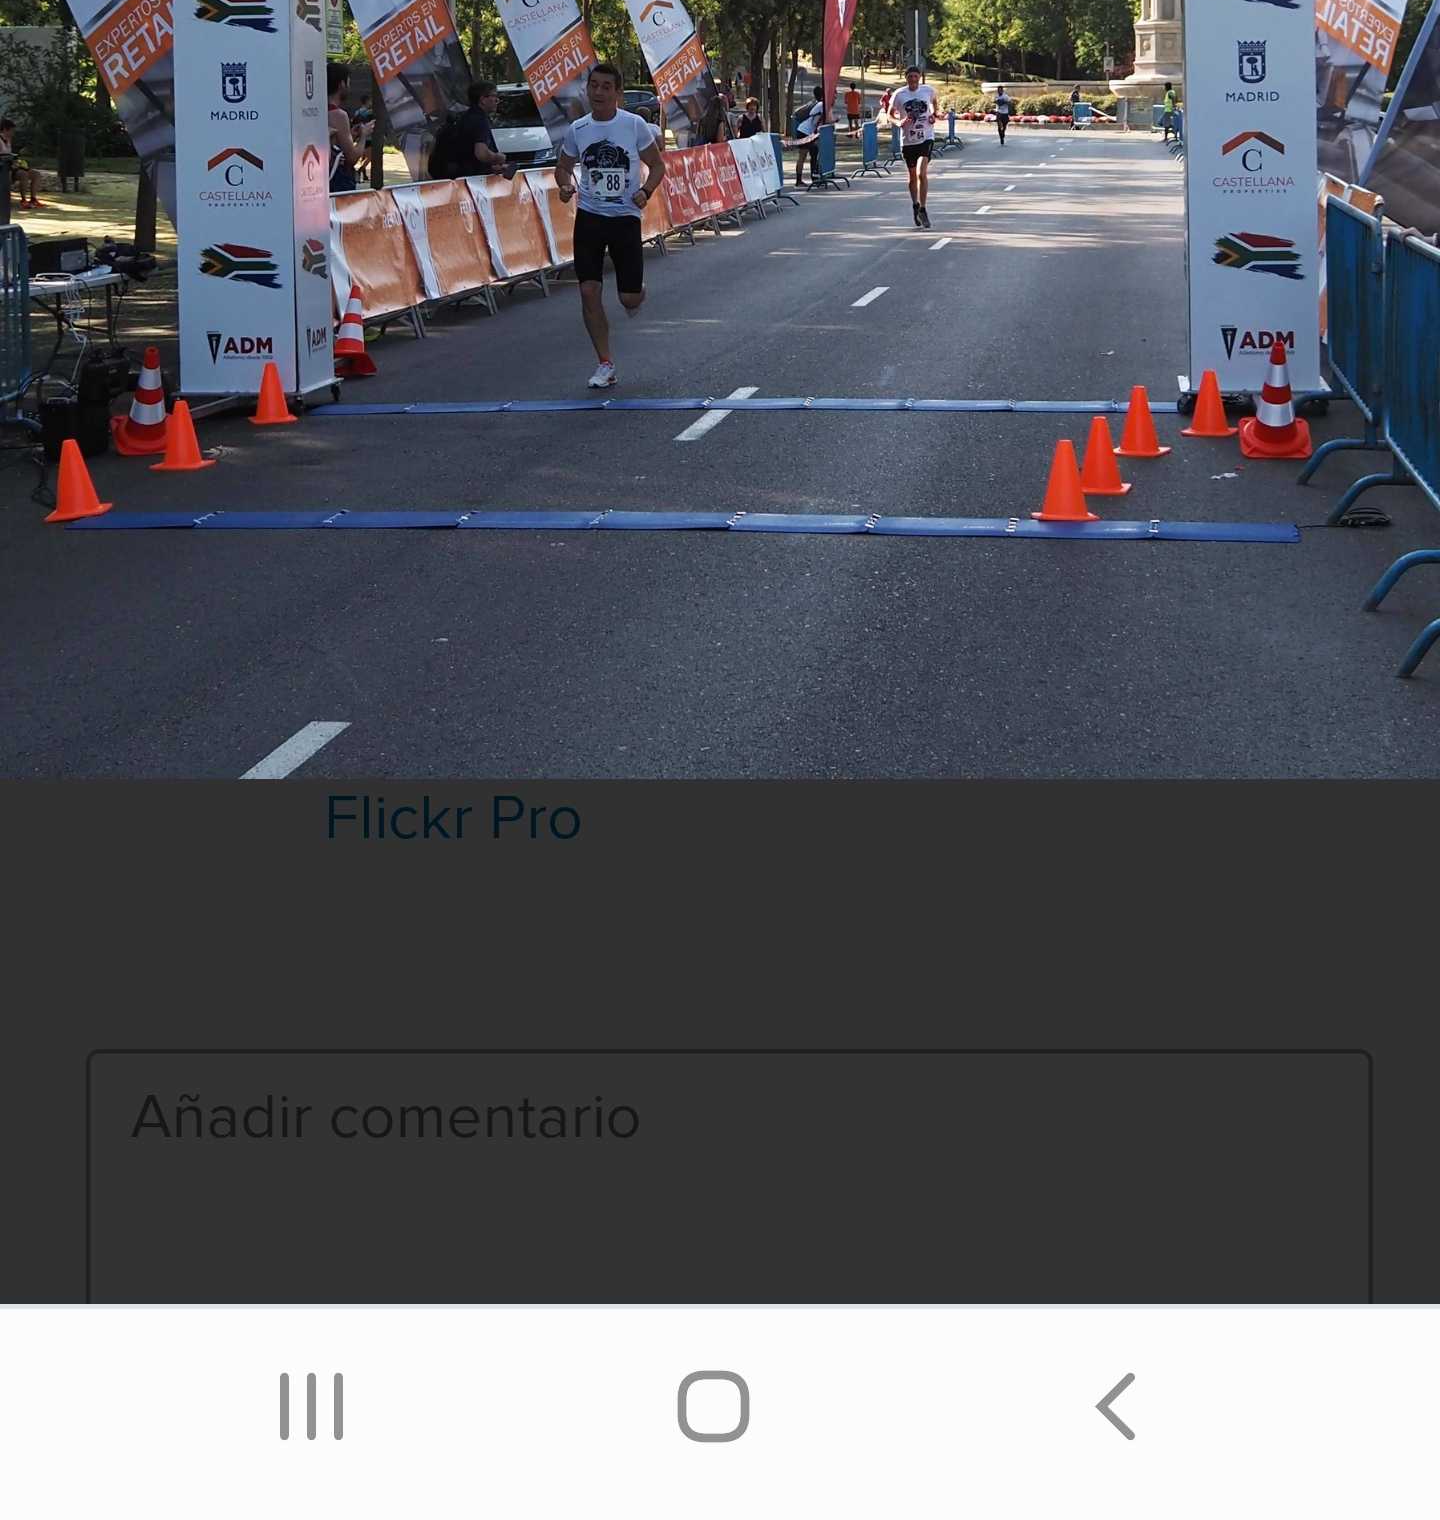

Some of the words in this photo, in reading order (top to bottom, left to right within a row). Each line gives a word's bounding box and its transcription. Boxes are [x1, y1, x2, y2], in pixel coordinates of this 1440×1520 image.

[369, 11, 421, 57] EXPERTOS
[374, 14, 446, 80] RETAIL
[529, 42, 570, 84] EXPERTOS
[533, 47, 590, 102] RETAIL
[659, 55, 702, 99] RETAIL
[1225, 91, 1280, 103] MADRID
[210, 110, 259, 121] MADRID
[606, 174, 621, 191] 88
[1212, 176, 1295, 188] CASTELLANA
[199, 191, 273, 201] CASTELLANA
[223, 336, 273, 354] ADM
[311, 326, 328, 347] ADM
[1239, 330, 1295, 349] ADM
